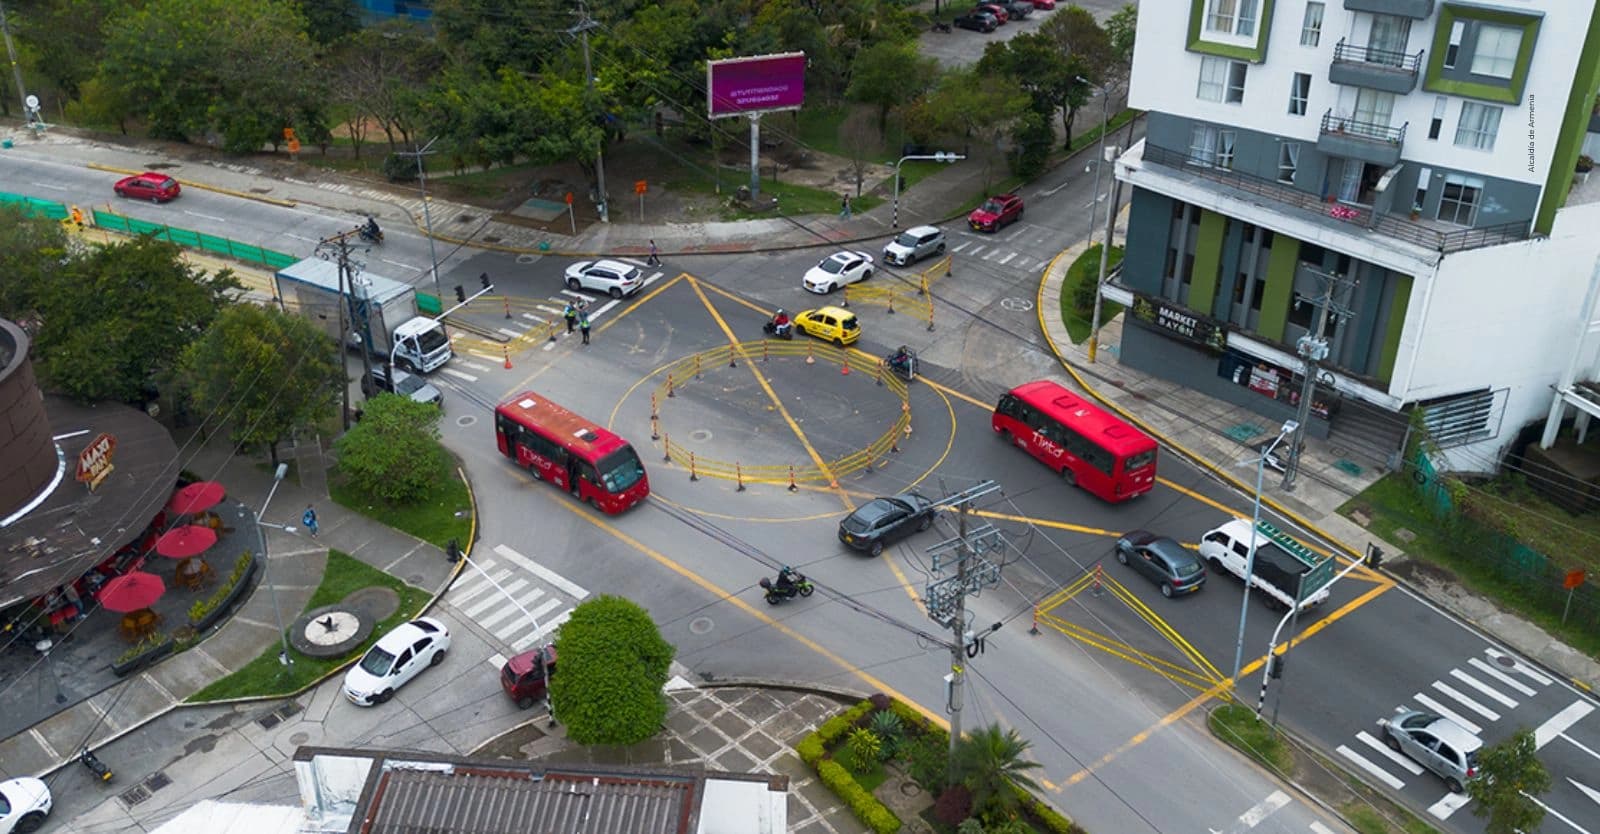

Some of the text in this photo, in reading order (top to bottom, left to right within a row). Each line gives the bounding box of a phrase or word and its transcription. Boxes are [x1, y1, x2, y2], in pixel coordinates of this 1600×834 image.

[1159, 306, 1197, 328] MARKET
[82, 437, 110, 472] MAXI
[90, 455, 108, 477] PAN
